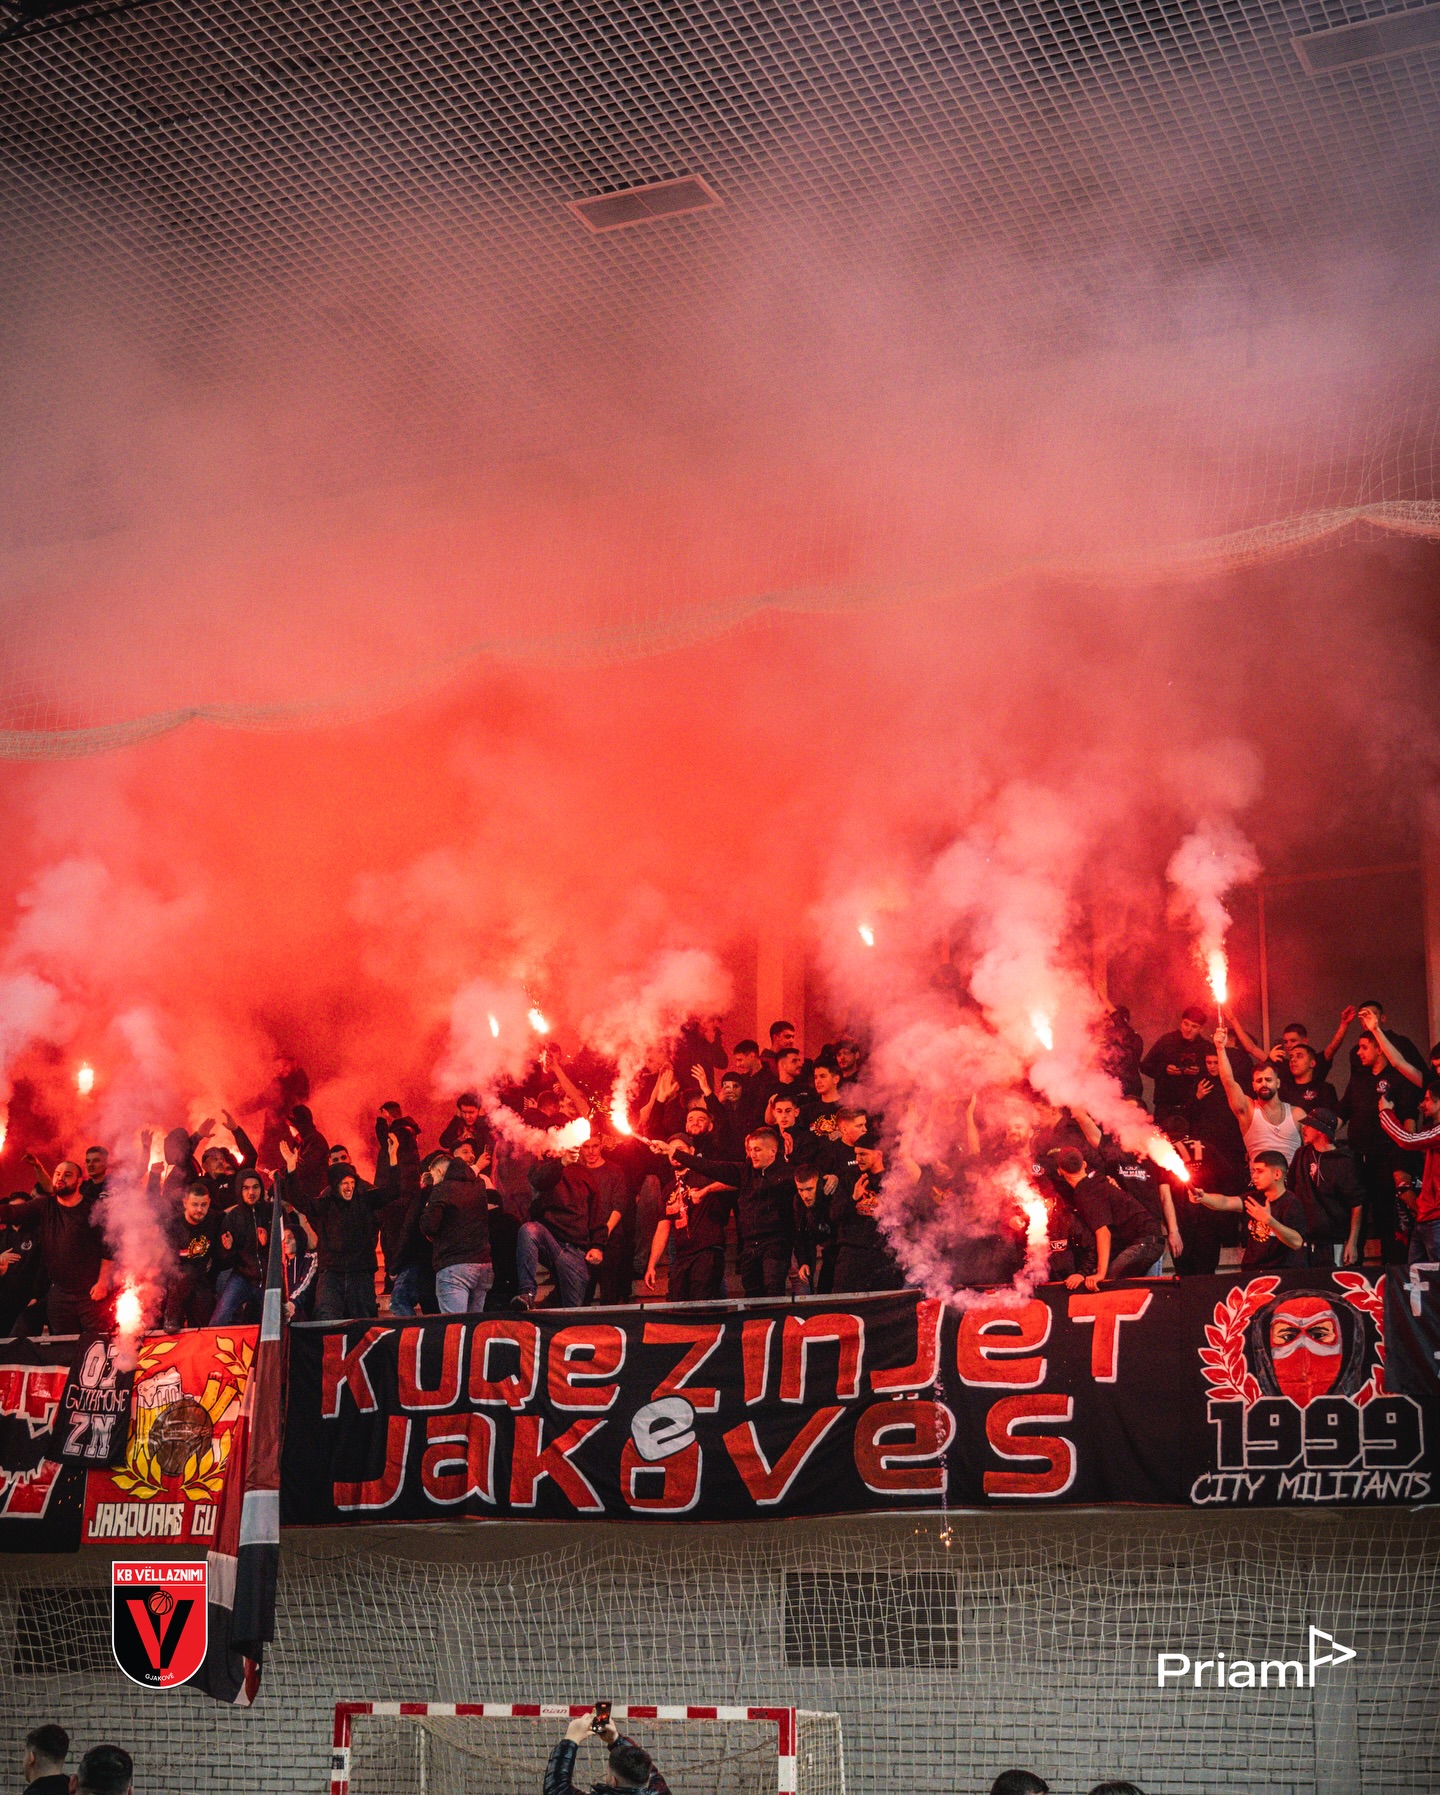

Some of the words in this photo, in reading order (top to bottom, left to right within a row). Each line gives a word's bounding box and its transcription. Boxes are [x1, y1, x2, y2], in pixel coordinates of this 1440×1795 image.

[1206, 1395, 1425, 1471] 1999
[1190, 1470, 1266, 1504] CITY
[1276, 1470, 1432, 1502] MILITANTS
